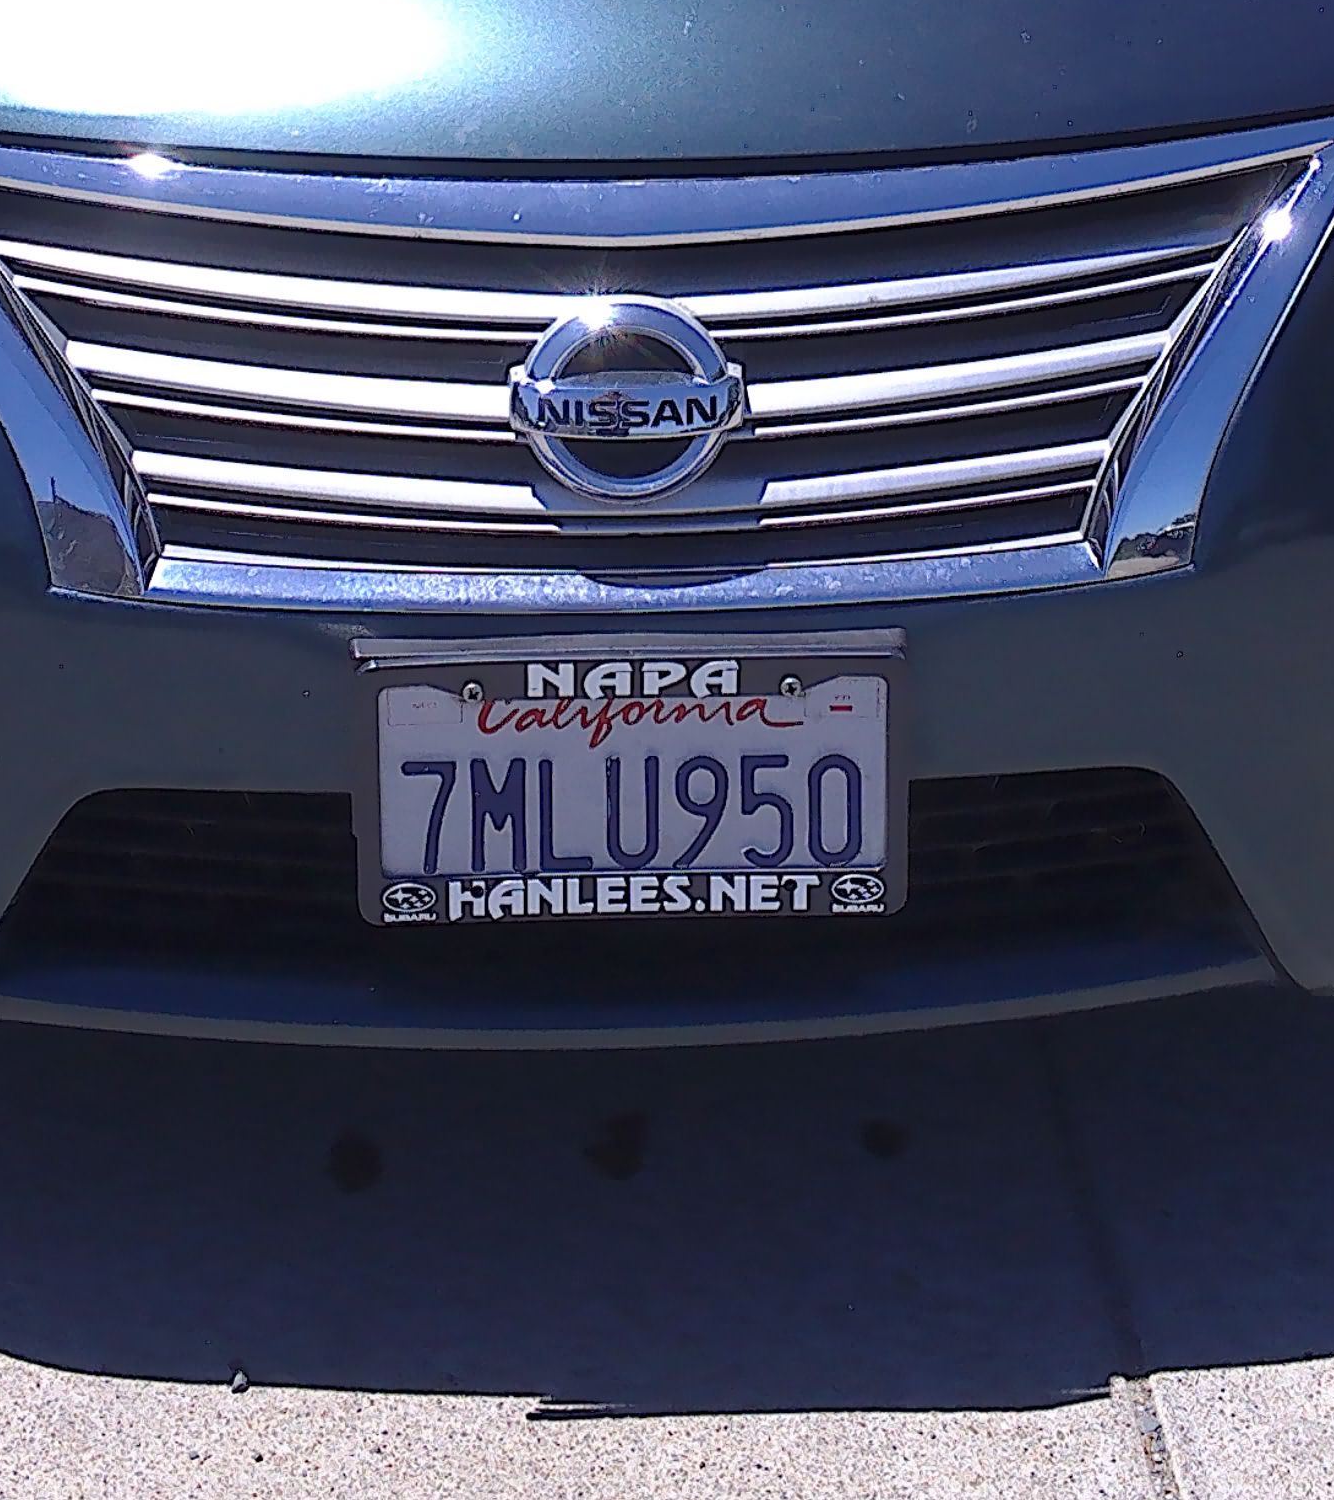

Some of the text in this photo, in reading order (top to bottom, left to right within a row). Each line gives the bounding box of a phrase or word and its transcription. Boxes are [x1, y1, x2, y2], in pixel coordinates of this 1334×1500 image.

[536, 395, 718, 429] NISSAN
[526, 660, 741, 700] NAPA
[478, 697, 804, 750] California
[400, 753, 863, 875] 7MLU950
[383, 912, 437, 924] SUBARU
[447, 875, 821, 922] HANLEES.NET
[831, 903, 885, 914] SUBARU
